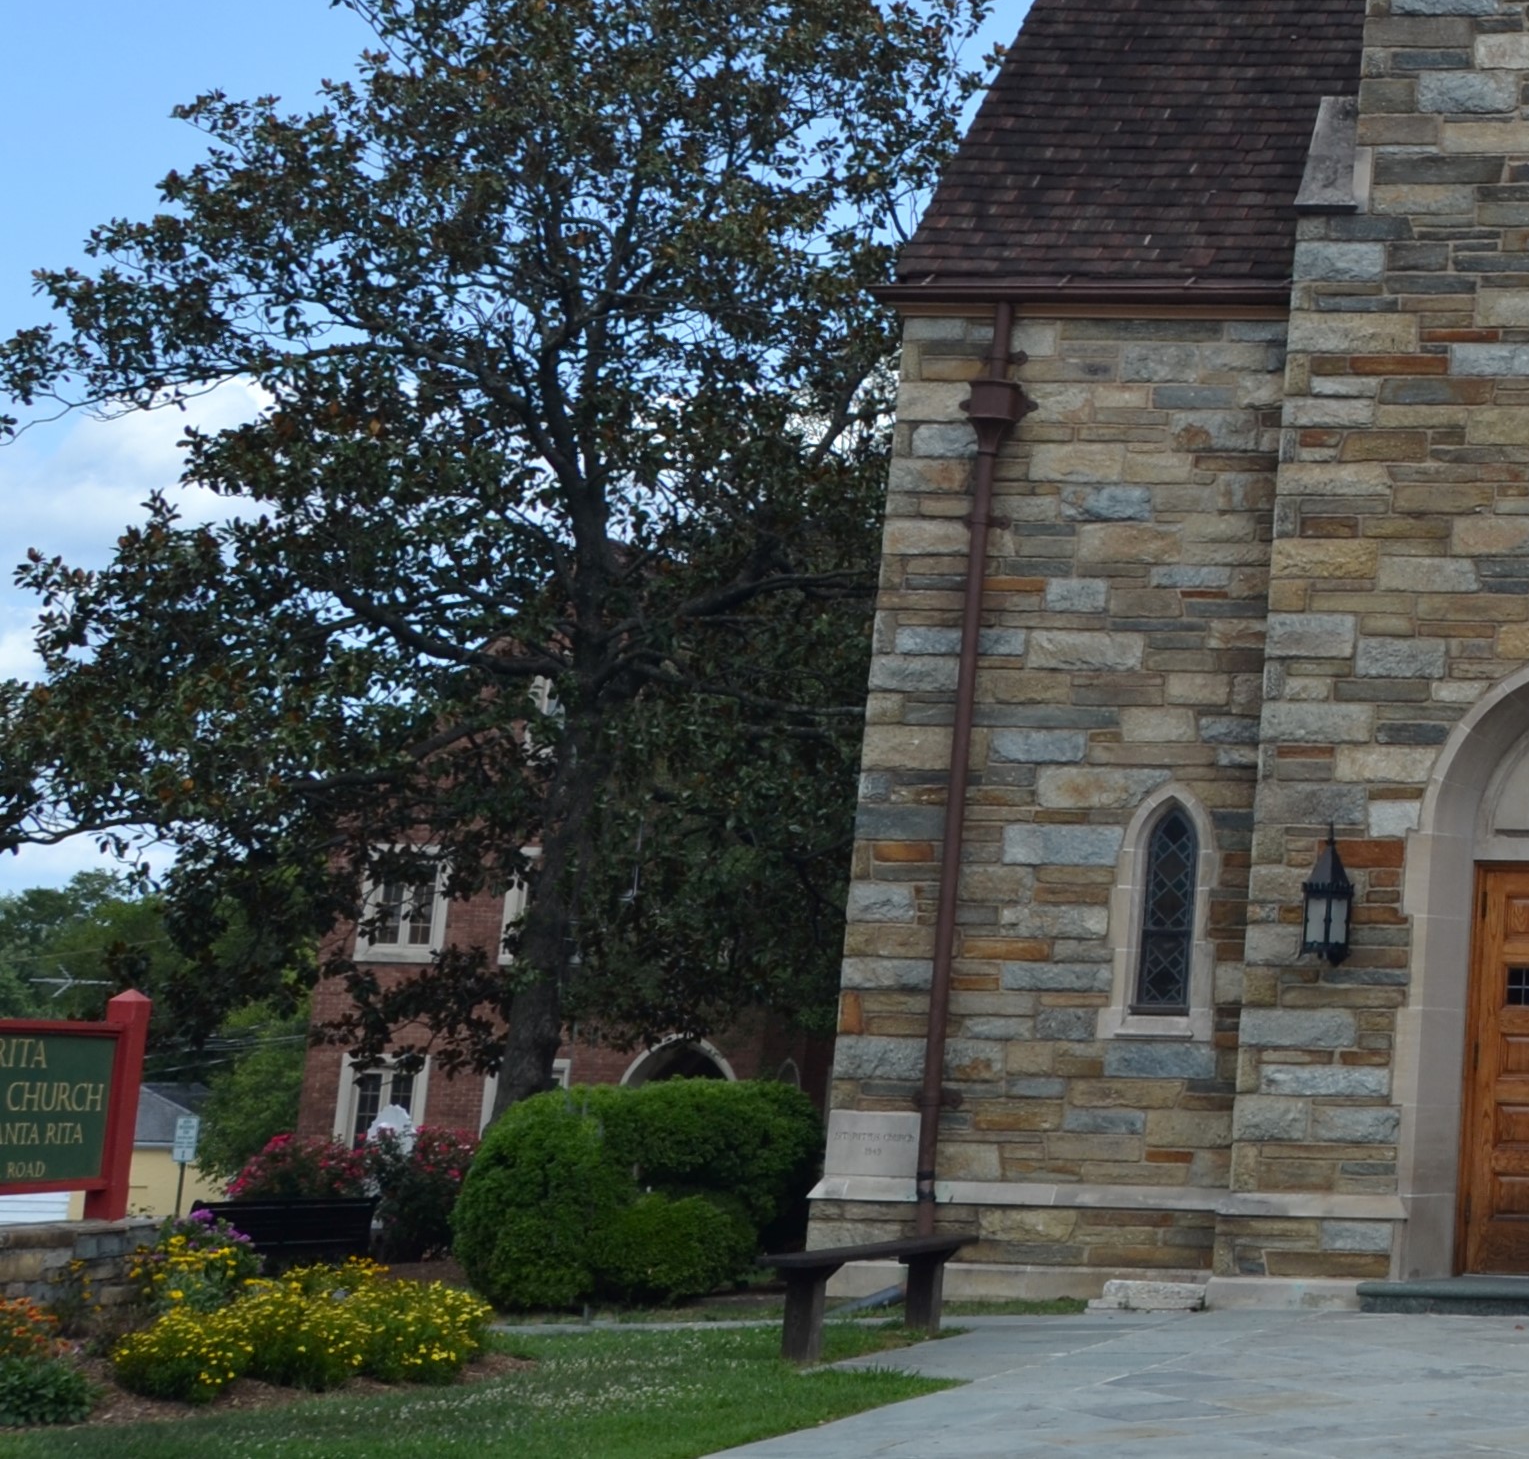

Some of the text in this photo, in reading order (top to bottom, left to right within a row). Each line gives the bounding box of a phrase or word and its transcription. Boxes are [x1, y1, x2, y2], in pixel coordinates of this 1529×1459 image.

[6, 1081, 104, 1111] CHURCH
[44, 1122, 83, 1144] RITA
[6, 1160, 46, 1179] ROAD
